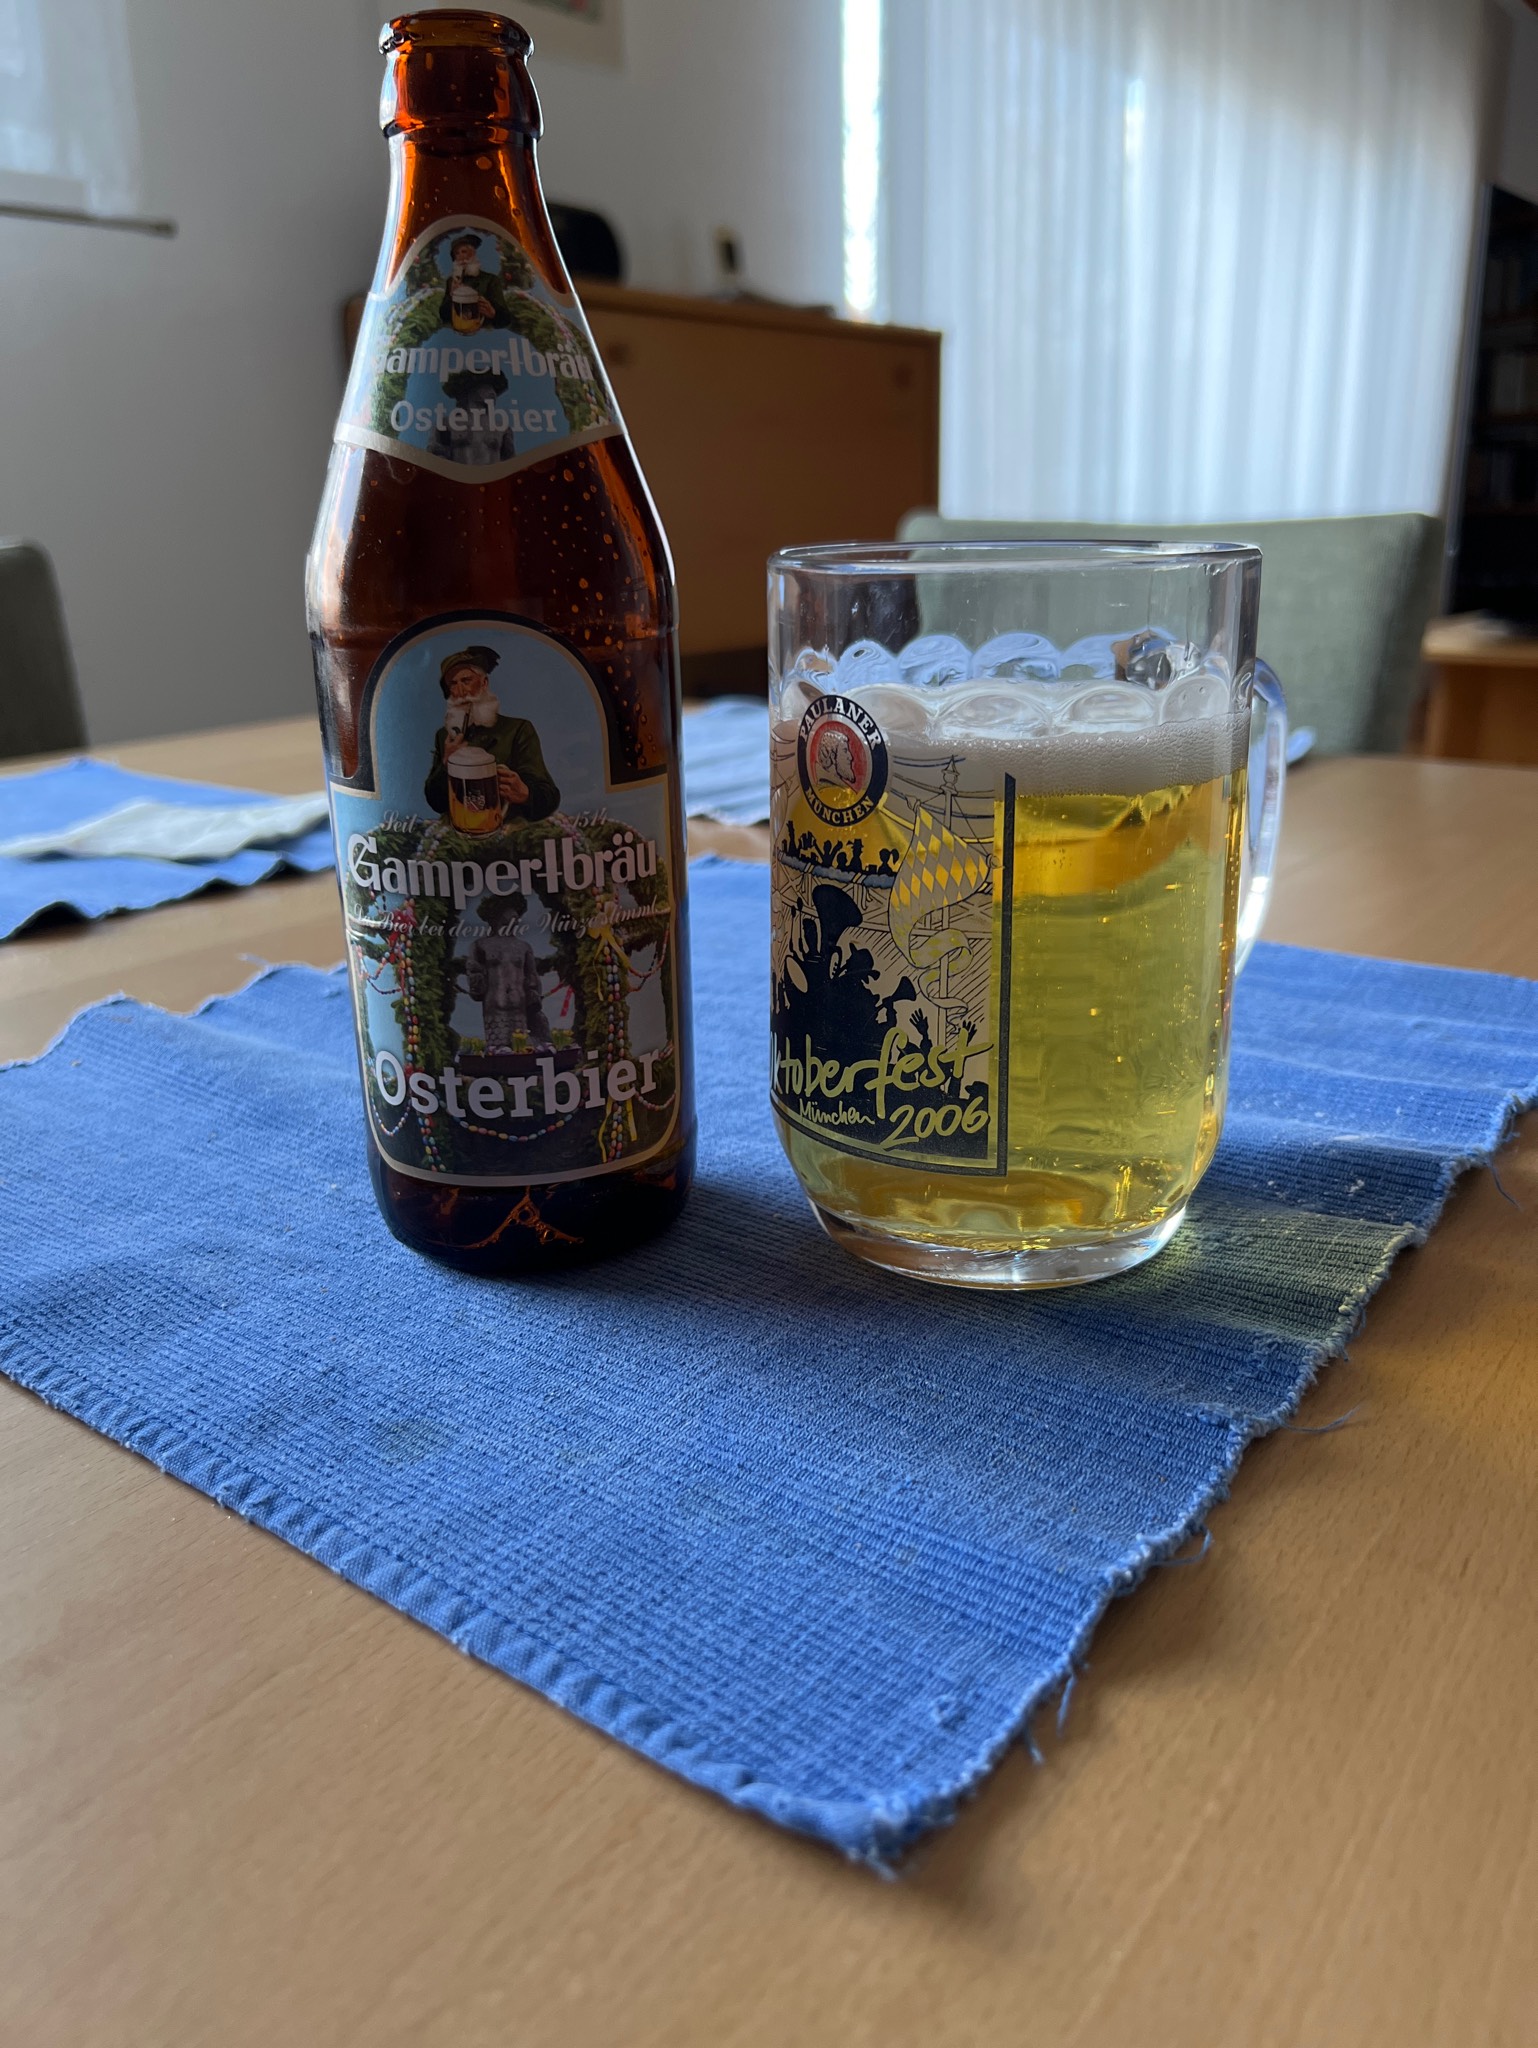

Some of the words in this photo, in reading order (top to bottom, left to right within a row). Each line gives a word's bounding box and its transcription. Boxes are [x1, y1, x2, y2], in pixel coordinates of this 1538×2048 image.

[390, 400, 557, 433] Osterbier
[800, 697, 882, 749] PAULANER
[382, 810, 417, 834] Seit
[378, 911, 417, 937] Bier
[448, 916, 494, 938] dem
[499, 916, 530, 938] die
[374, 1050, 659, 1119] Osterbier
[770, 1027, 994, 1119] ktoberfest
[799, 1099, 875, 1125] München
[879, 1096, 989, 1149] 2006
